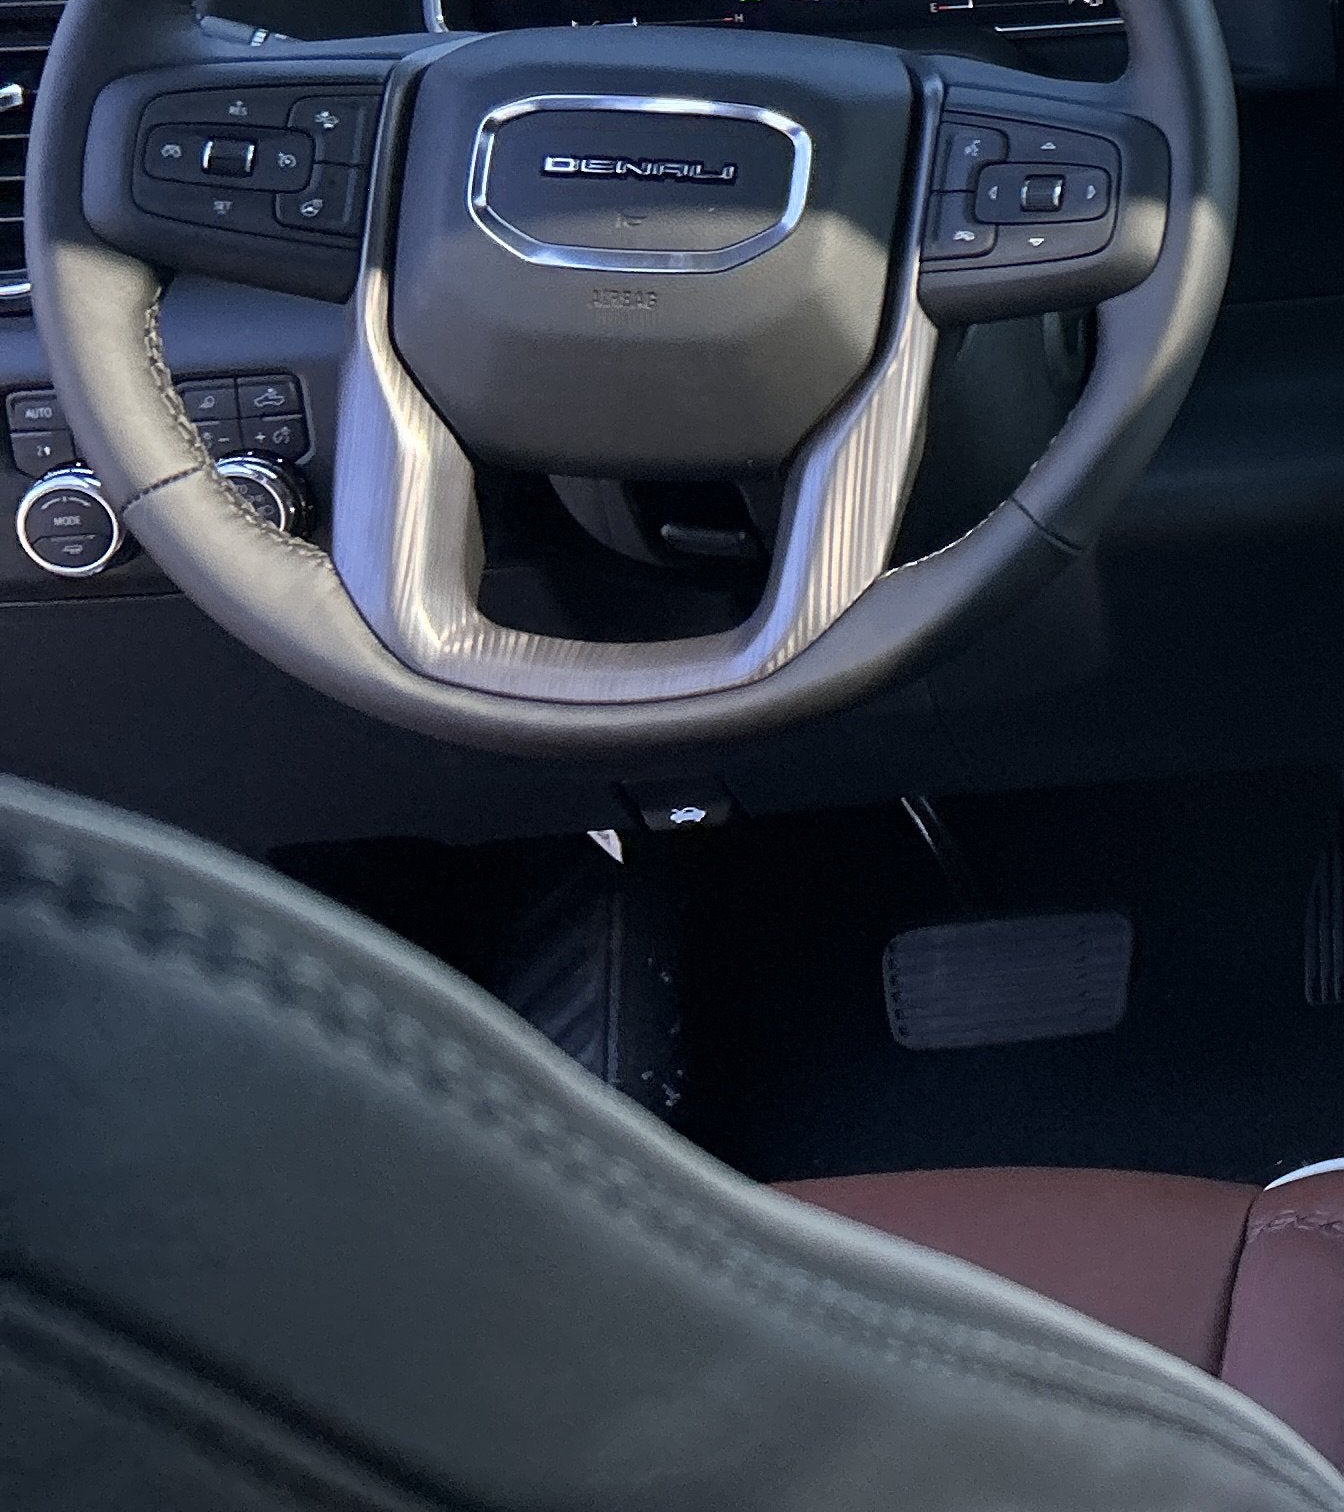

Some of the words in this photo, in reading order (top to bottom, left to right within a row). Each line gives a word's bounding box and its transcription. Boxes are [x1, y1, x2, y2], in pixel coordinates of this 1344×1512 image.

[544, 156, 735, 181] DENALI
[25, 407, 53, 419] AUTO
[53, 515, 81, 527] MODE
